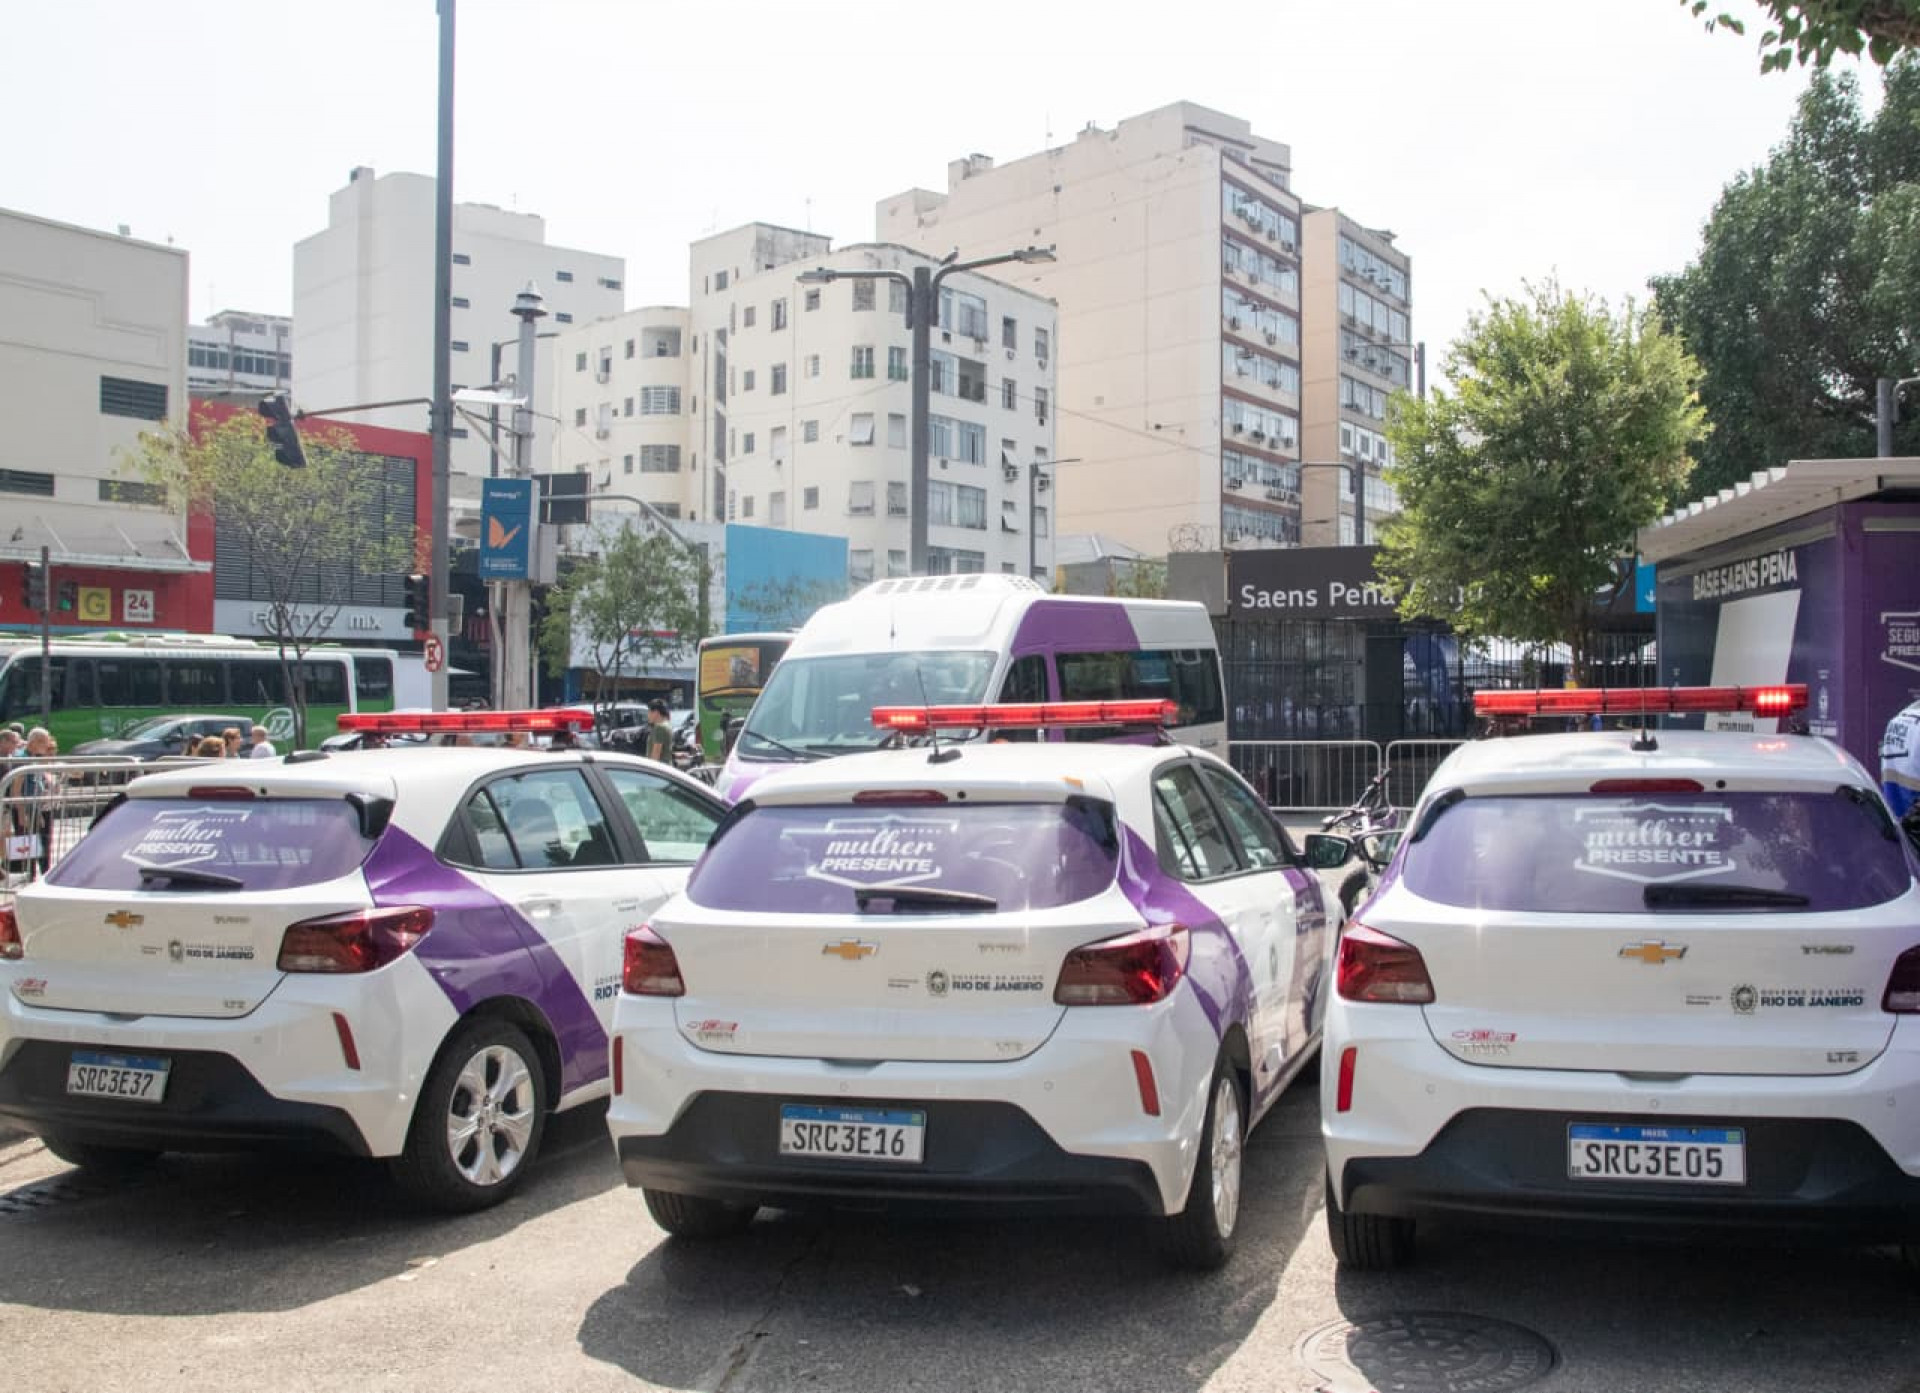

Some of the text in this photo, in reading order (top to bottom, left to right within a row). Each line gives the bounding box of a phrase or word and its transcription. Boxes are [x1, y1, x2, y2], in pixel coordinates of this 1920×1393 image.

[1693, 547, 1798, 600] BASE SAENS PEÑA
[85, 592, 105, 615] G
[129, 594, 148, 610] 24
[1241, 584, 1317, 608] Saens
[1889, 628, 1920, 643] SEGU
[144, 820, 223, 841] mulher
[1584, 819, 1718, 847] mulher
[132, 842, 216, 854] PRESENTE
[825, 828, 936, 856] mulher
[820, 857, 933, 872] PRESENTE
[1588, 850, 1722, 865] PRESENTE
[187, 949, 201, 959] RIO
[216, 950, 254, 960] JANEIRO
[952, 981, 1044, 991] RIO DE JANEIRO
[1761, 996, 1864, 1007] RIO DE JANEIRO
[73, 1066, 153, 1097] SRC3E37
[792, 1122, 904, 1156] SRC3E16
[1585, 1143, 1722, 1178] SRC3E05
